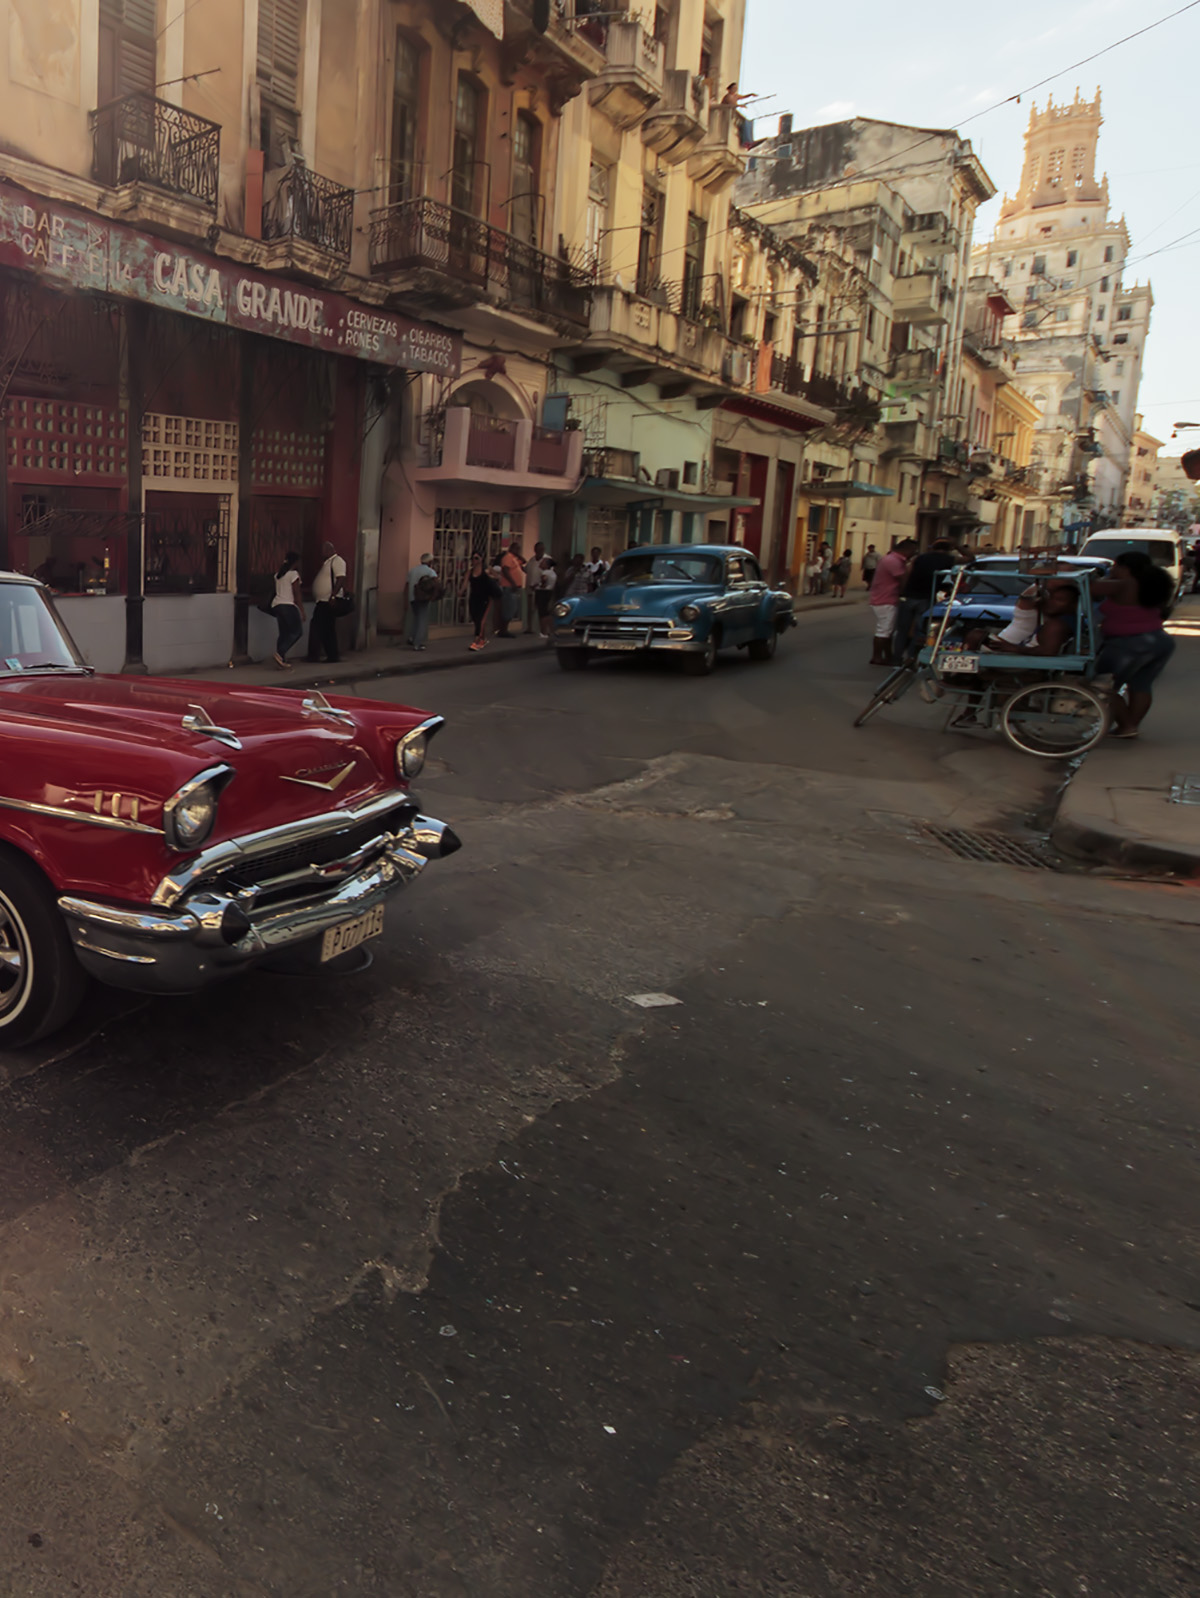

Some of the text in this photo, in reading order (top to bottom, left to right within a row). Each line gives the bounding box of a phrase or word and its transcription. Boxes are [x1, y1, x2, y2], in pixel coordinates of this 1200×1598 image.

[23, 205, 65, 239] BAR
[153, 252, 224, 309] CASA
[347, 310, 398, 338] CERVEZAS
[345, 329, 380, 352] RONES
[409, 328, 453, 353] CIGARROS
